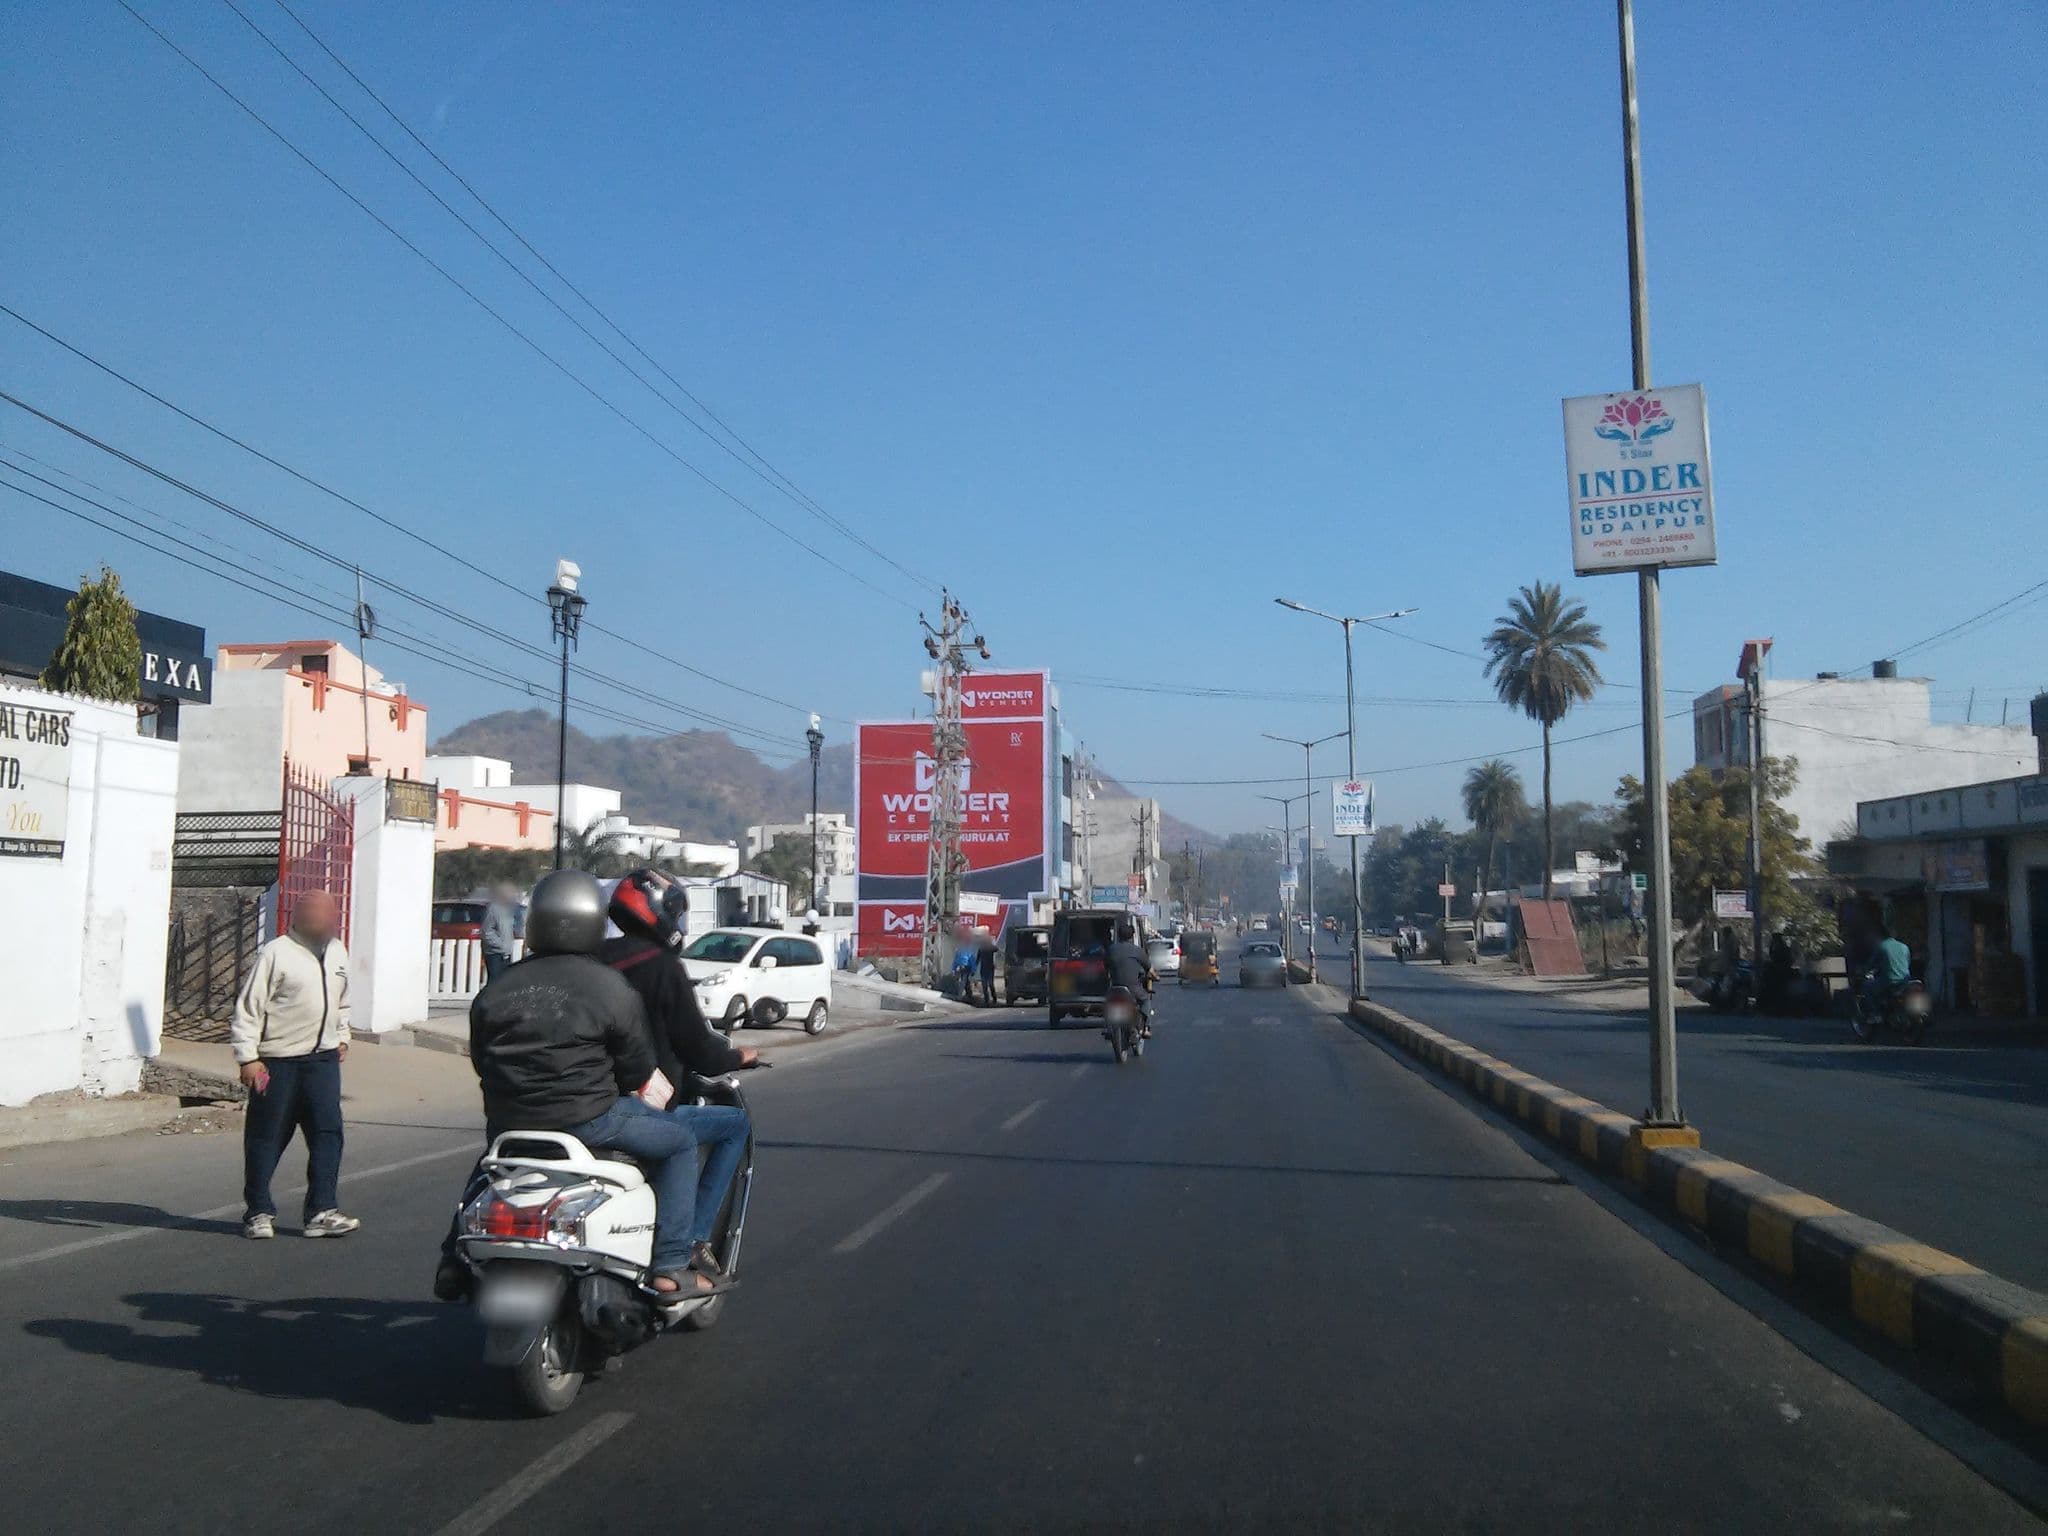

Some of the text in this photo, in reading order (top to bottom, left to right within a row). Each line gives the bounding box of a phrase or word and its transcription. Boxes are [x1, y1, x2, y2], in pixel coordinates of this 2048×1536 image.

[1578, 462, 1702, 498] INDER
[1580, 498, 1703, 522] RESIDENCY
[1581, 515, 1706, 536] UDAIPUR
[144, 652, 202, 691] EXA
[977, 691, 1033, 699] WONDER
[26, 710, 70, 747] CARS
[882, 793, 1009, 812] WOER
[889, 813, 1009, 823] CEENT
[888, 834, 901, 842] EK
[959, 832, 1010, 842] HURUAAT
